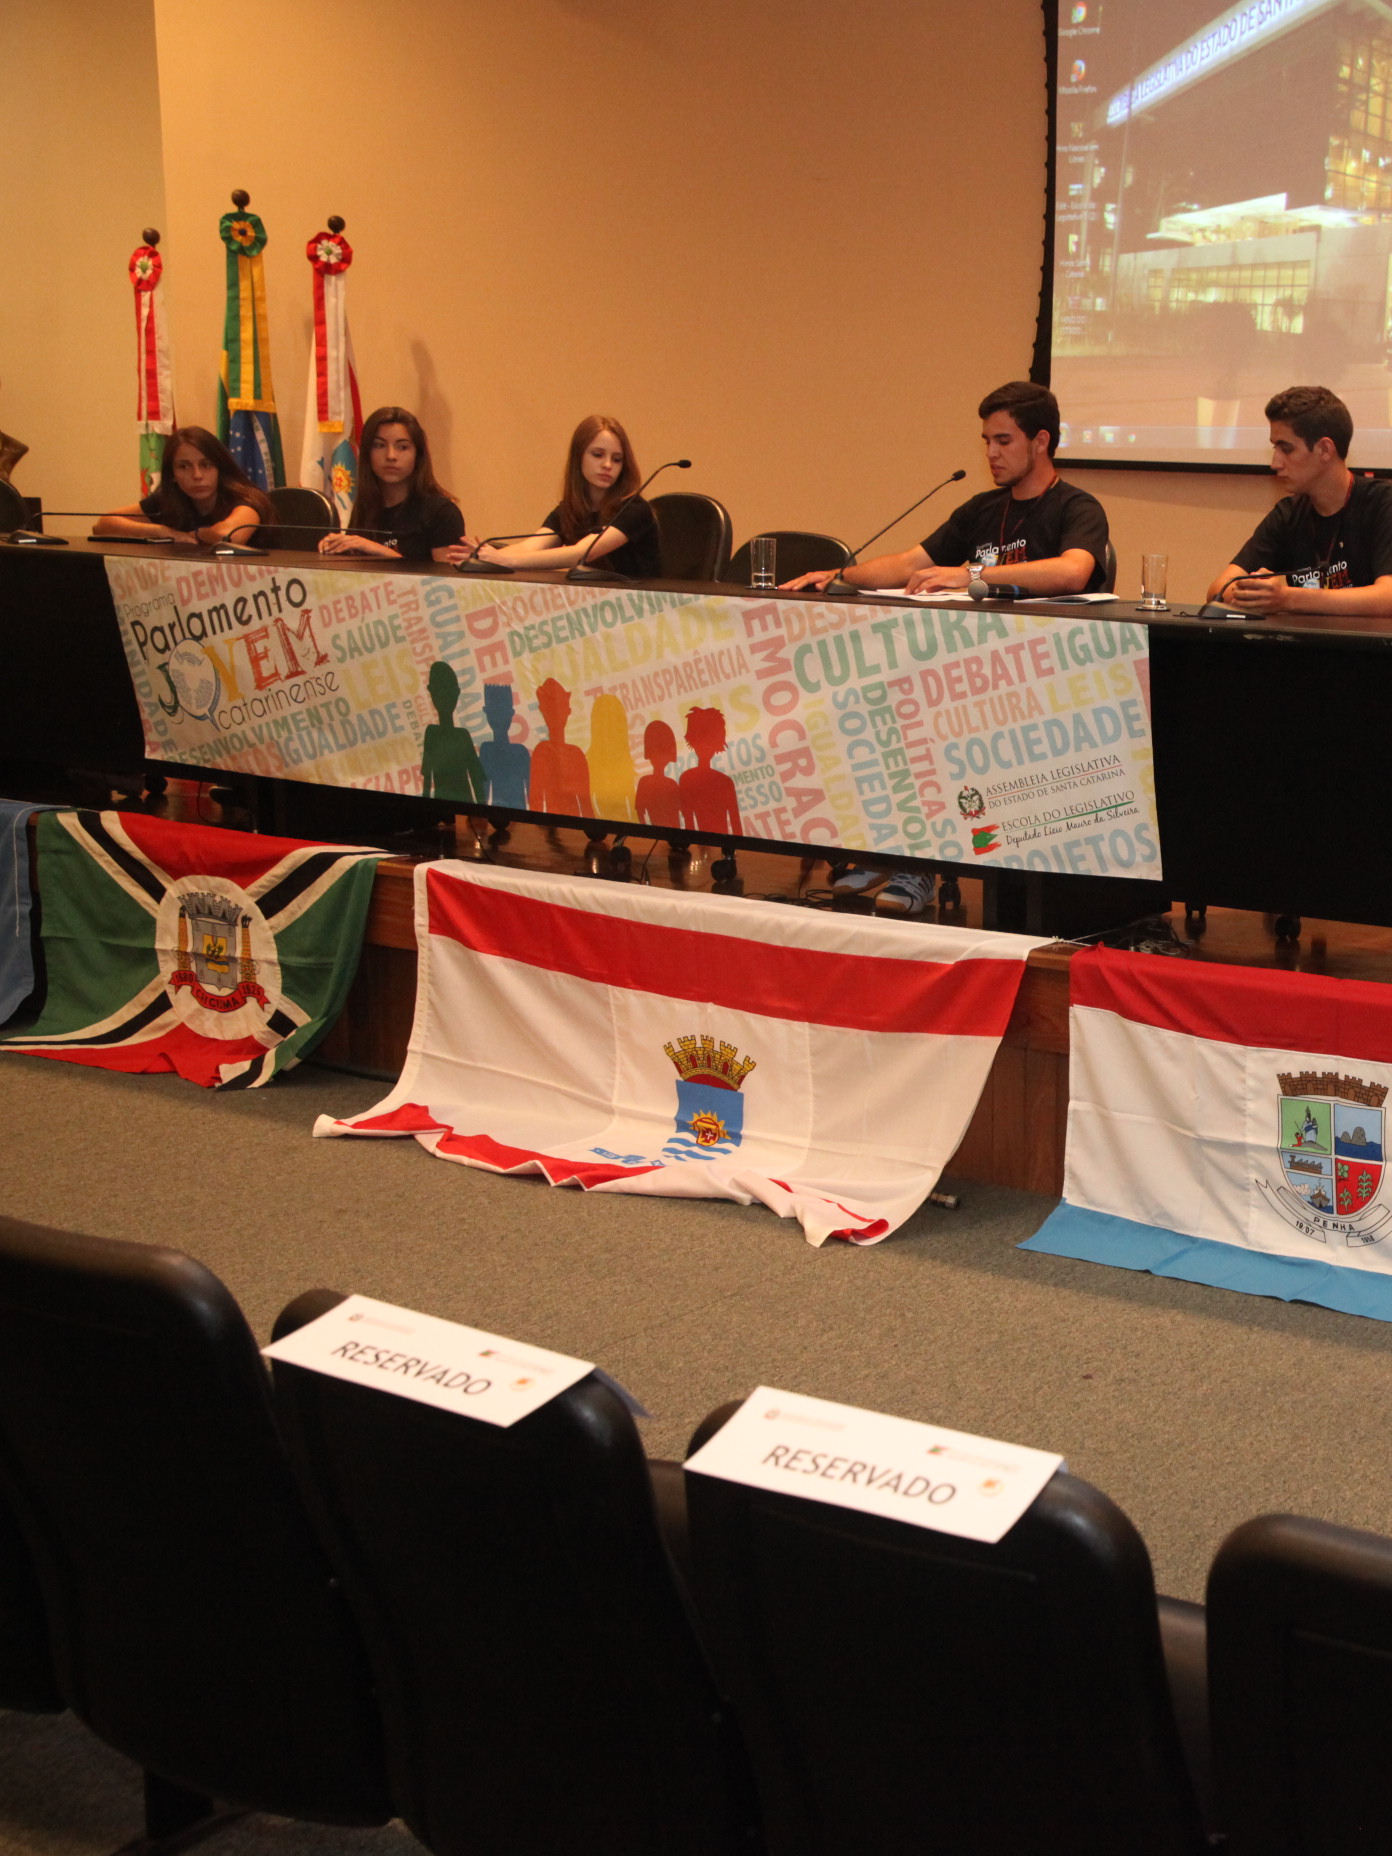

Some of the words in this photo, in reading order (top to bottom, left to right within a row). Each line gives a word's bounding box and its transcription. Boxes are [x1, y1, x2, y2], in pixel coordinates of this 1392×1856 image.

[122, 592, 176, 620] Programa
[130, 576, 307, 661] Parlamento
[318, 580, 400, 629] DEBATE
[331, 612, 407, 664] SAÚDE
[793, 608, 1009, 694] CULTURA
[156, 608, 331, 732] JOVEM
[341, 648, 421, 710] LEIS
[607, 643, 750, 712] TRANSPARÊNCIA
[919, 636, 1055, 708] DEBATE
[1044, 662, 1134, 714] LEIS
[217, 670, 341, 730] catarinense
[932, 686, 1045, 742] CULTURA
[274, 702, 405, 769] IGUALDADE
[887, 675, 947, 821] POLÍTICA
[943, 698, 1147, 781] SOCIEDADE
[985, 773, 1048, 797] ASSEMBLEIA
[1050, 754, 1121, 780] LEGISLATIVA
[988, 799, 1002, 810] DO
[1004, 791, 1035, 807] ESTADO
[1037, 788, 1049, 798] DE
[1050, 781, 1079, 795] SANTA
[1080, 768, 1126, 786] CATARINA
[1002, 815, 1041, 832] ESCOLA
[1043, 808, 1061, 822] DO
[1063, 790, 1135, 818] LEGISLATIVO
[1005, 829, 1042, 848] Deputado
[1065, 819, 1092, 832] Mauro
[1094, 812, 1105, 824] da
[1106, 806, 1140, 821] Silveira
[1313, 1216, 1355, 1231] PENHA
[330, 1340, 493, 1396] RESERVADO
[761, 1444, 958, 1505] RESERVADO
